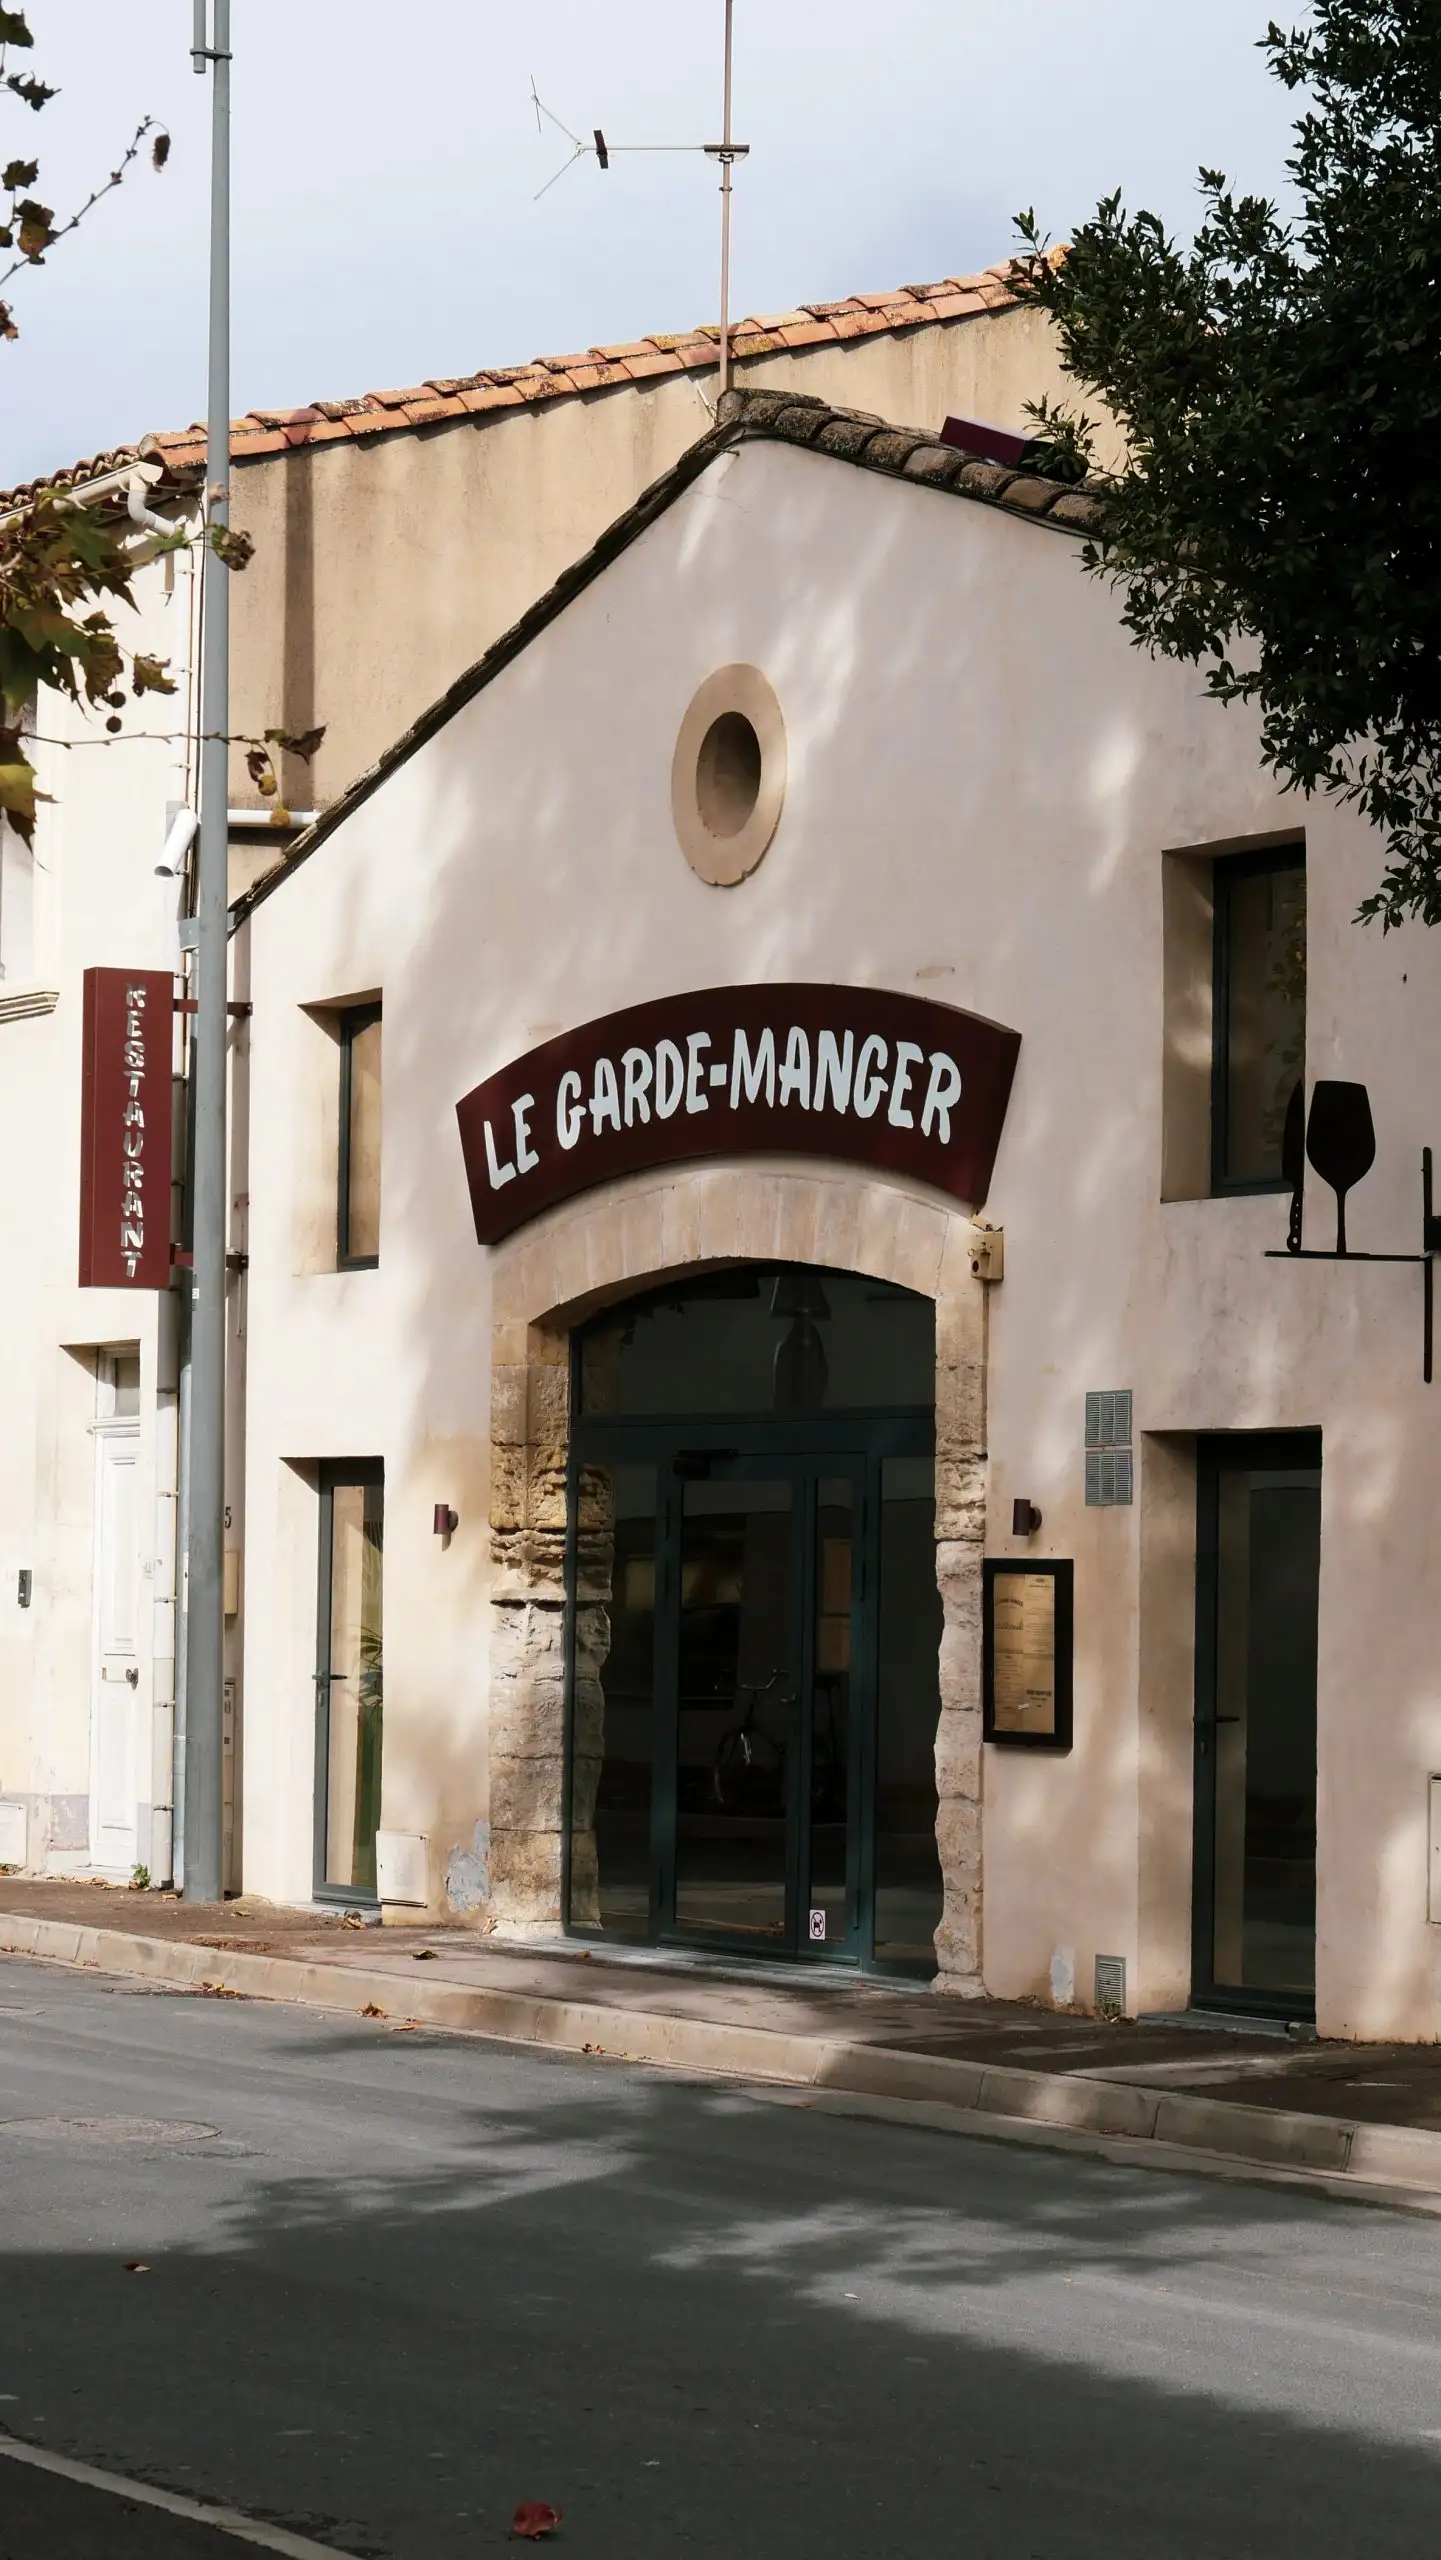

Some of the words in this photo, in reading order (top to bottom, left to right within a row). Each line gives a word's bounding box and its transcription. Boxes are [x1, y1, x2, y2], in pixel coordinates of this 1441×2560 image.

[120, 983, 147, 1278] RESTAURANT
[484, 1094, 540, 1190] LE
[556, 1026, 962, 1150] GARDE-MANGER
